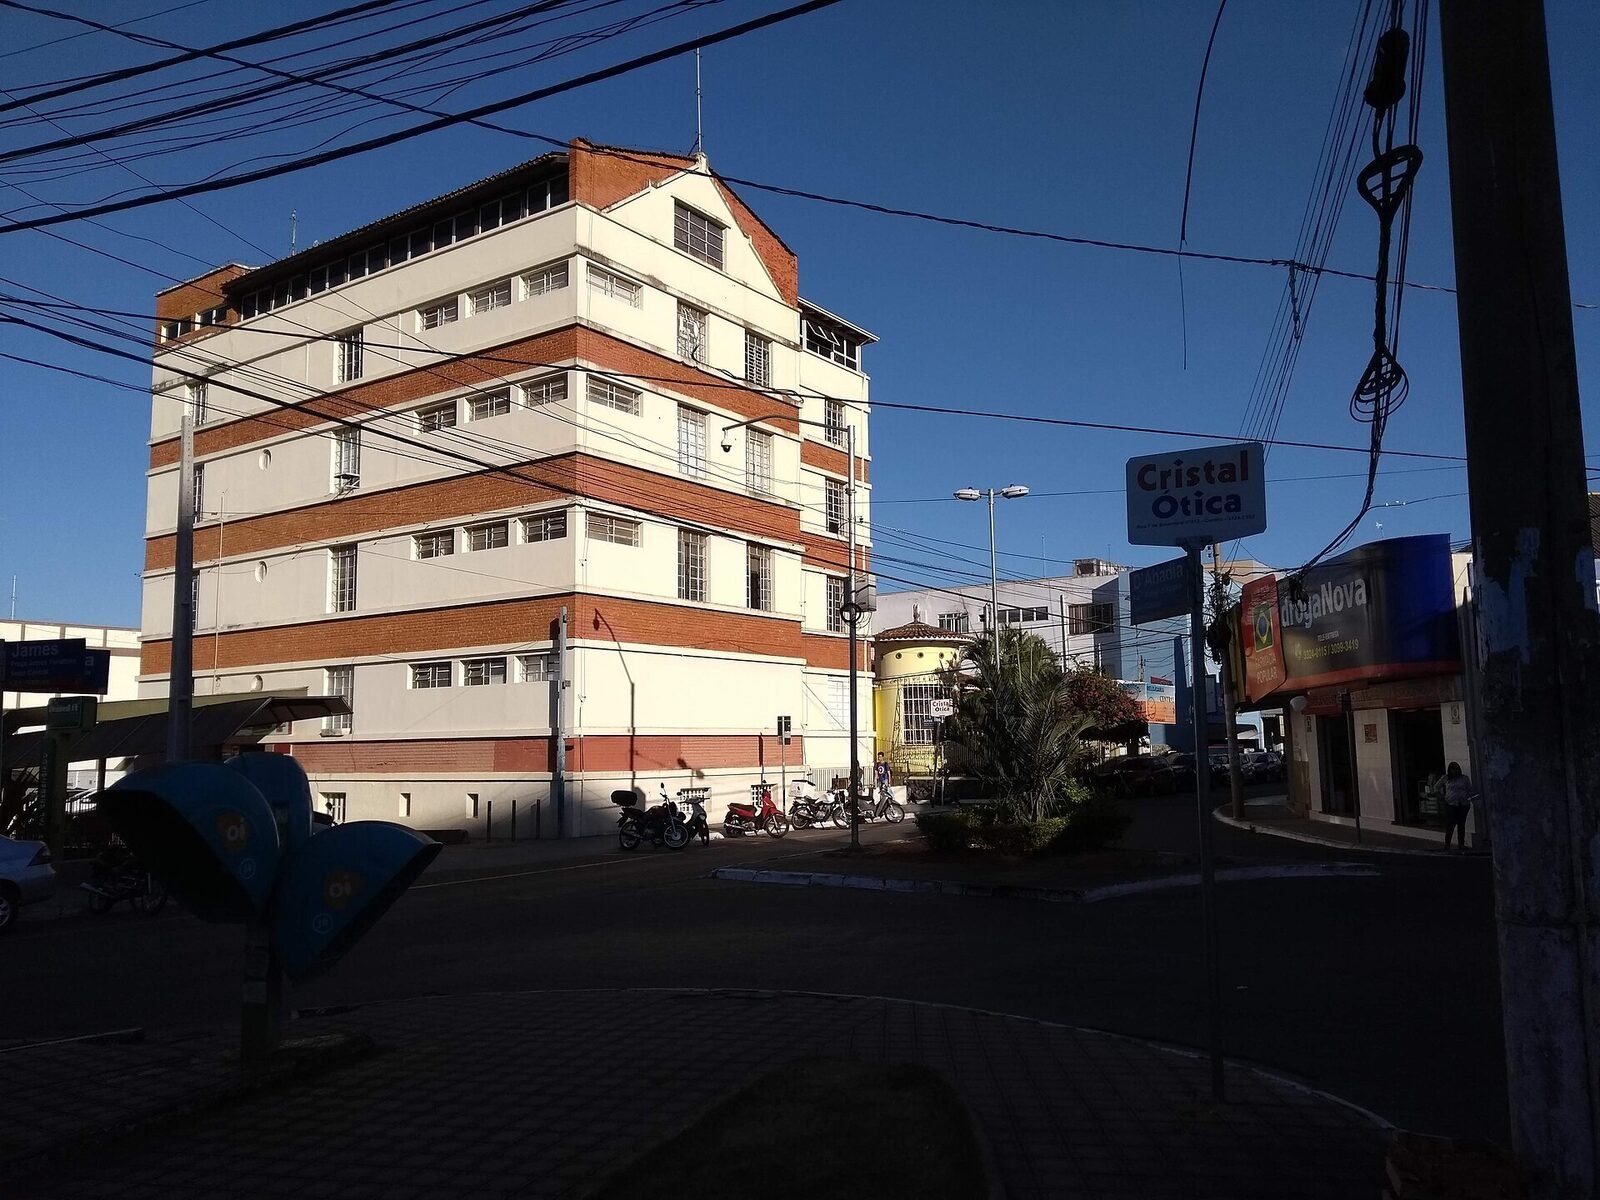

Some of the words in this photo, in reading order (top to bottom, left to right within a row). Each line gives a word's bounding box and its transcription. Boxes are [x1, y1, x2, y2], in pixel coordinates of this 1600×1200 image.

[1137, 450, 1249, 491] Cristal
[1152, 490, 1241, 519] Ótica
[1281, 578, 1367, 629] drogaNova
[12, 643, 60, 658] James
[227, 816, 246, 841] oi
[329, 873, 351, 898] oi
